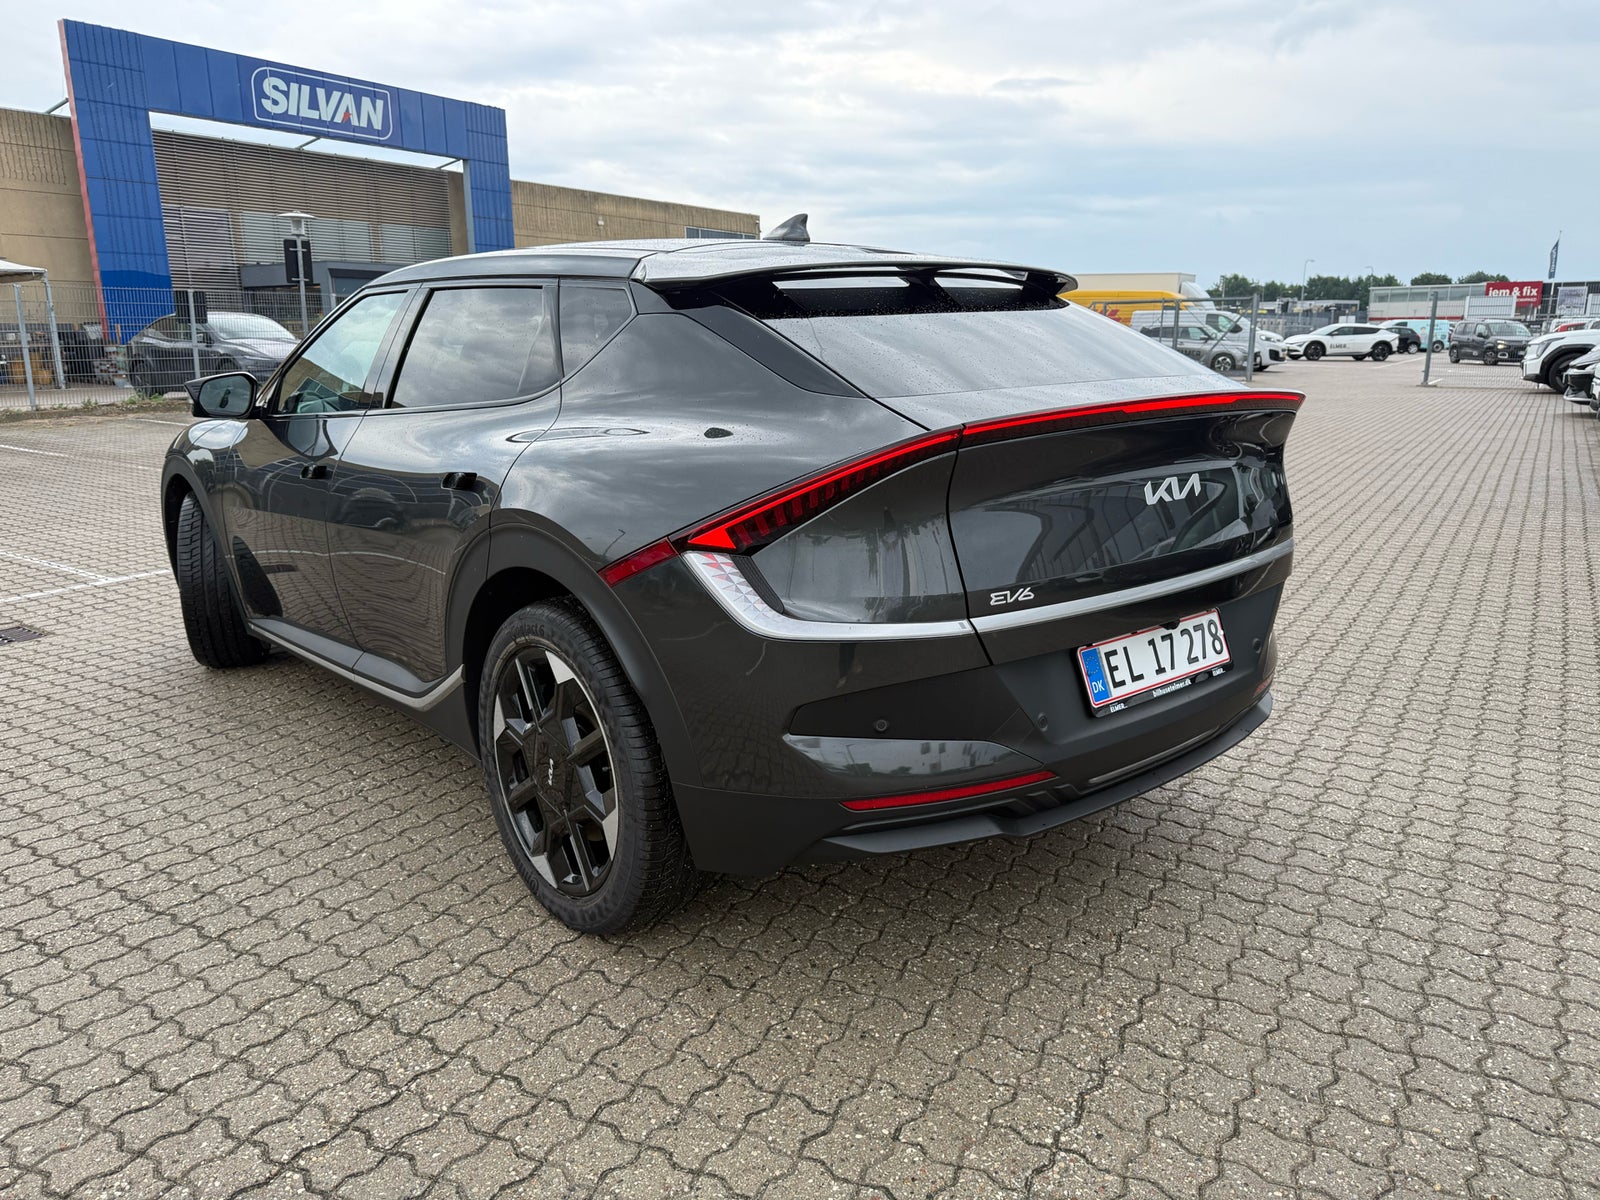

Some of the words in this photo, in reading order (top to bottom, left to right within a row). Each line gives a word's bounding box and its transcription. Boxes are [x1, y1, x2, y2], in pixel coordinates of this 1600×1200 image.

[260, 76, 384, 131] SILVAN
[1512, 286, 1520, 296] &
[1522, 286, 1538, 296] fix
[1143, 473, 1201, 505] KIA
[989, 586, 1035, 606] EV6
[1104, 646, 1144, 688] EL
[1092, 680, 1105, 693] DK
